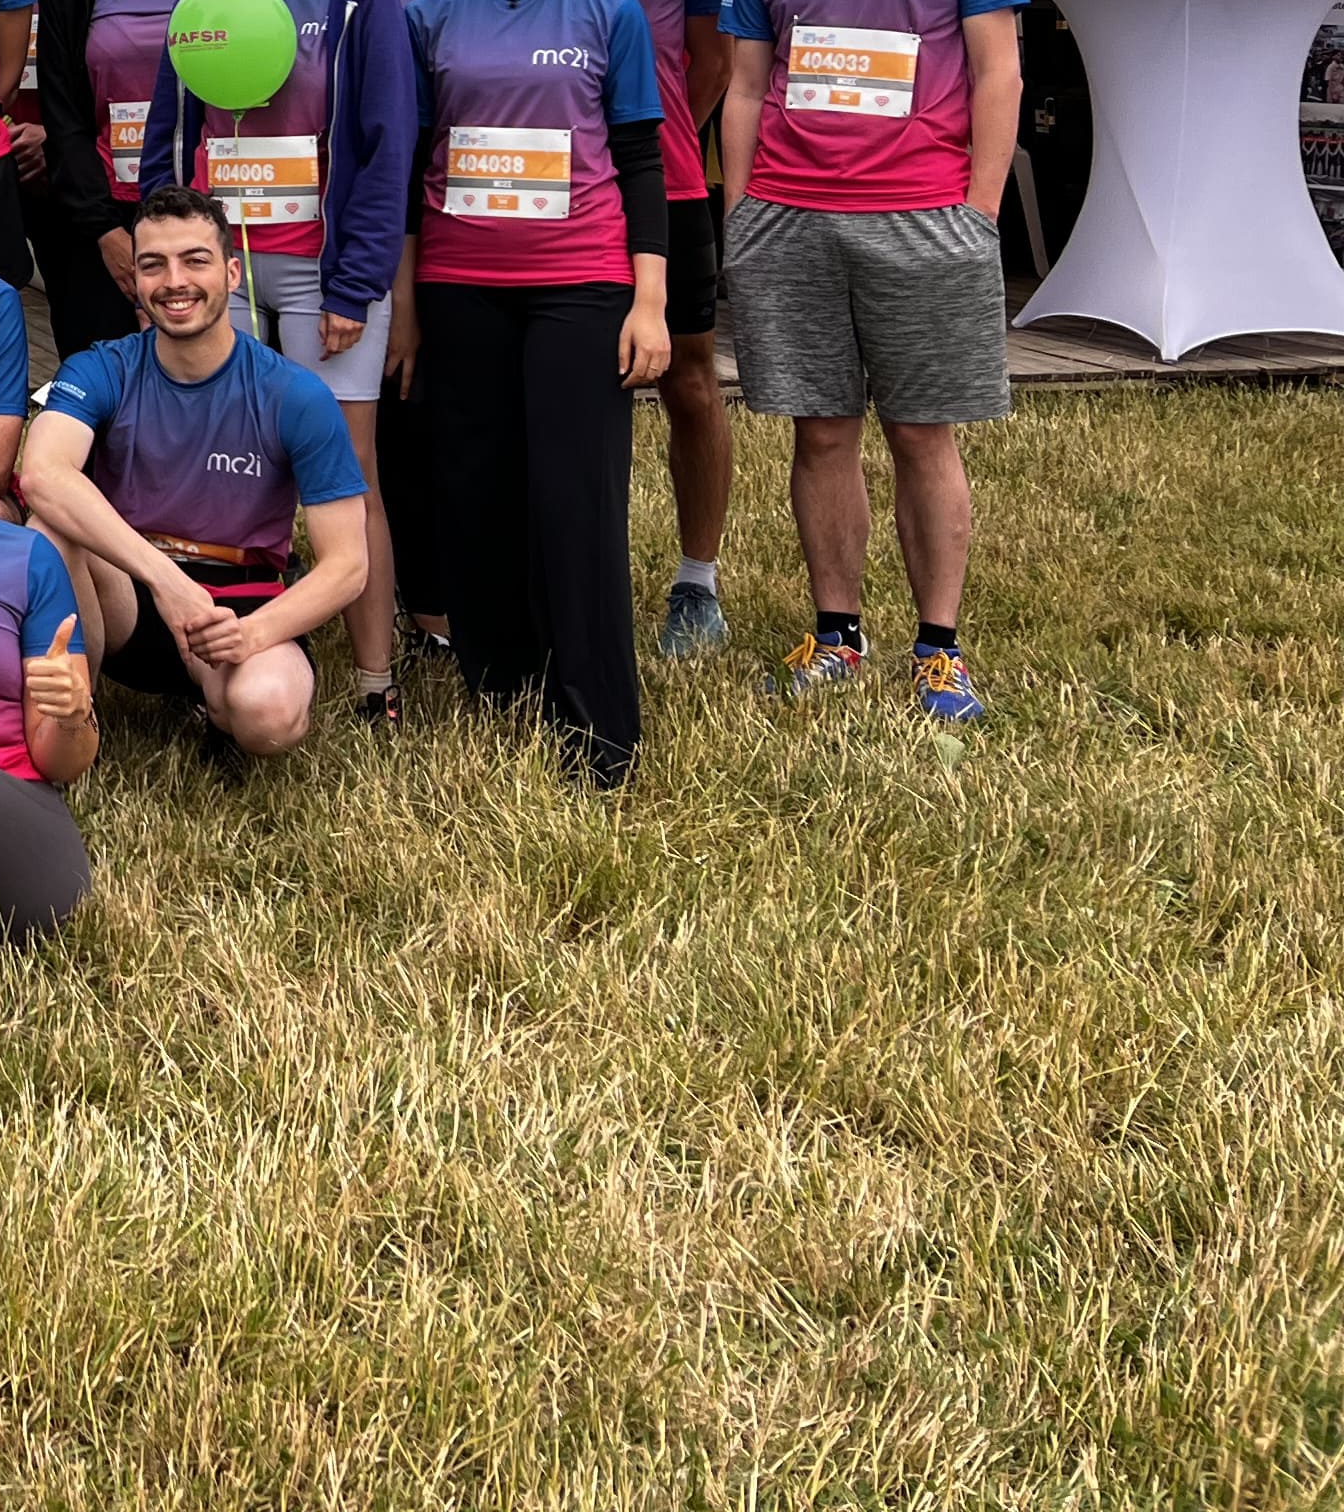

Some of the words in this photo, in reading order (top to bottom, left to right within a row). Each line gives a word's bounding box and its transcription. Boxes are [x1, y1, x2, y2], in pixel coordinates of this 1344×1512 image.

[179, 29, 227, 44] AFSR
[532, 47, 588, 69] mc2i
[800, 51, 870, 73] 404033
[119, 127, 145, 143] 404
[215, 164, 275, 181] 404006
[457, 153, 525, 174] 404038
[207, 453, 261, 477] mc2i
